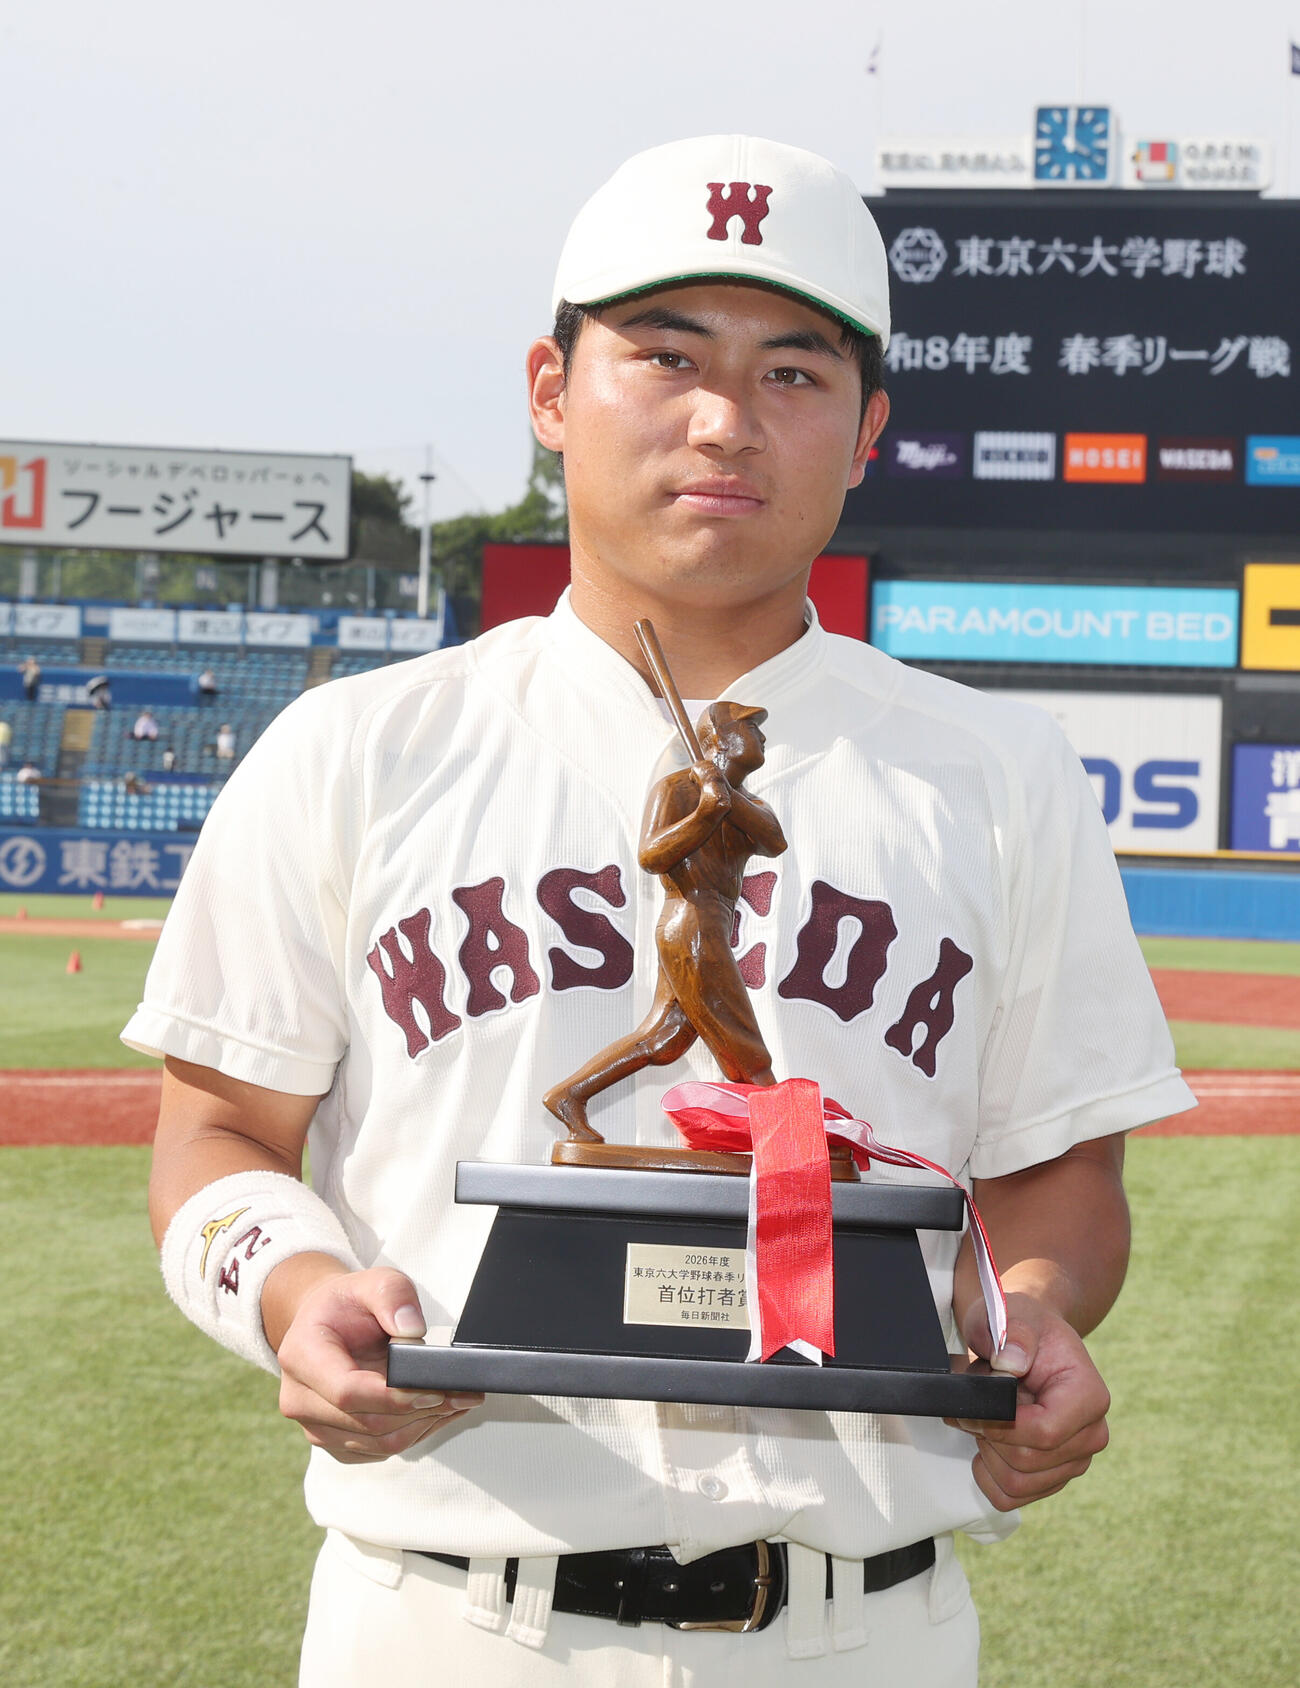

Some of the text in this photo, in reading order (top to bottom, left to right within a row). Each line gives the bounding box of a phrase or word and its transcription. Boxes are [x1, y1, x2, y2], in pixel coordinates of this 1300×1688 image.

[706, 182, 773, 246] W
[953, 236, 1248, 279] 東京六大学野球
[1058, 333, 1291, 378] 春季リーグ戦
[1068, 448, 1142, 468] HOSEI
[1160, 448, 1233, 471] WASEDA
[61, 487, 332, 544] フージャース
[876, 604, 1232, 641] PARAMOUNT BED
[685, 1254, 731, 1268] 2026年度
[681, 1310, 730, 1322] 毎日新聞社
